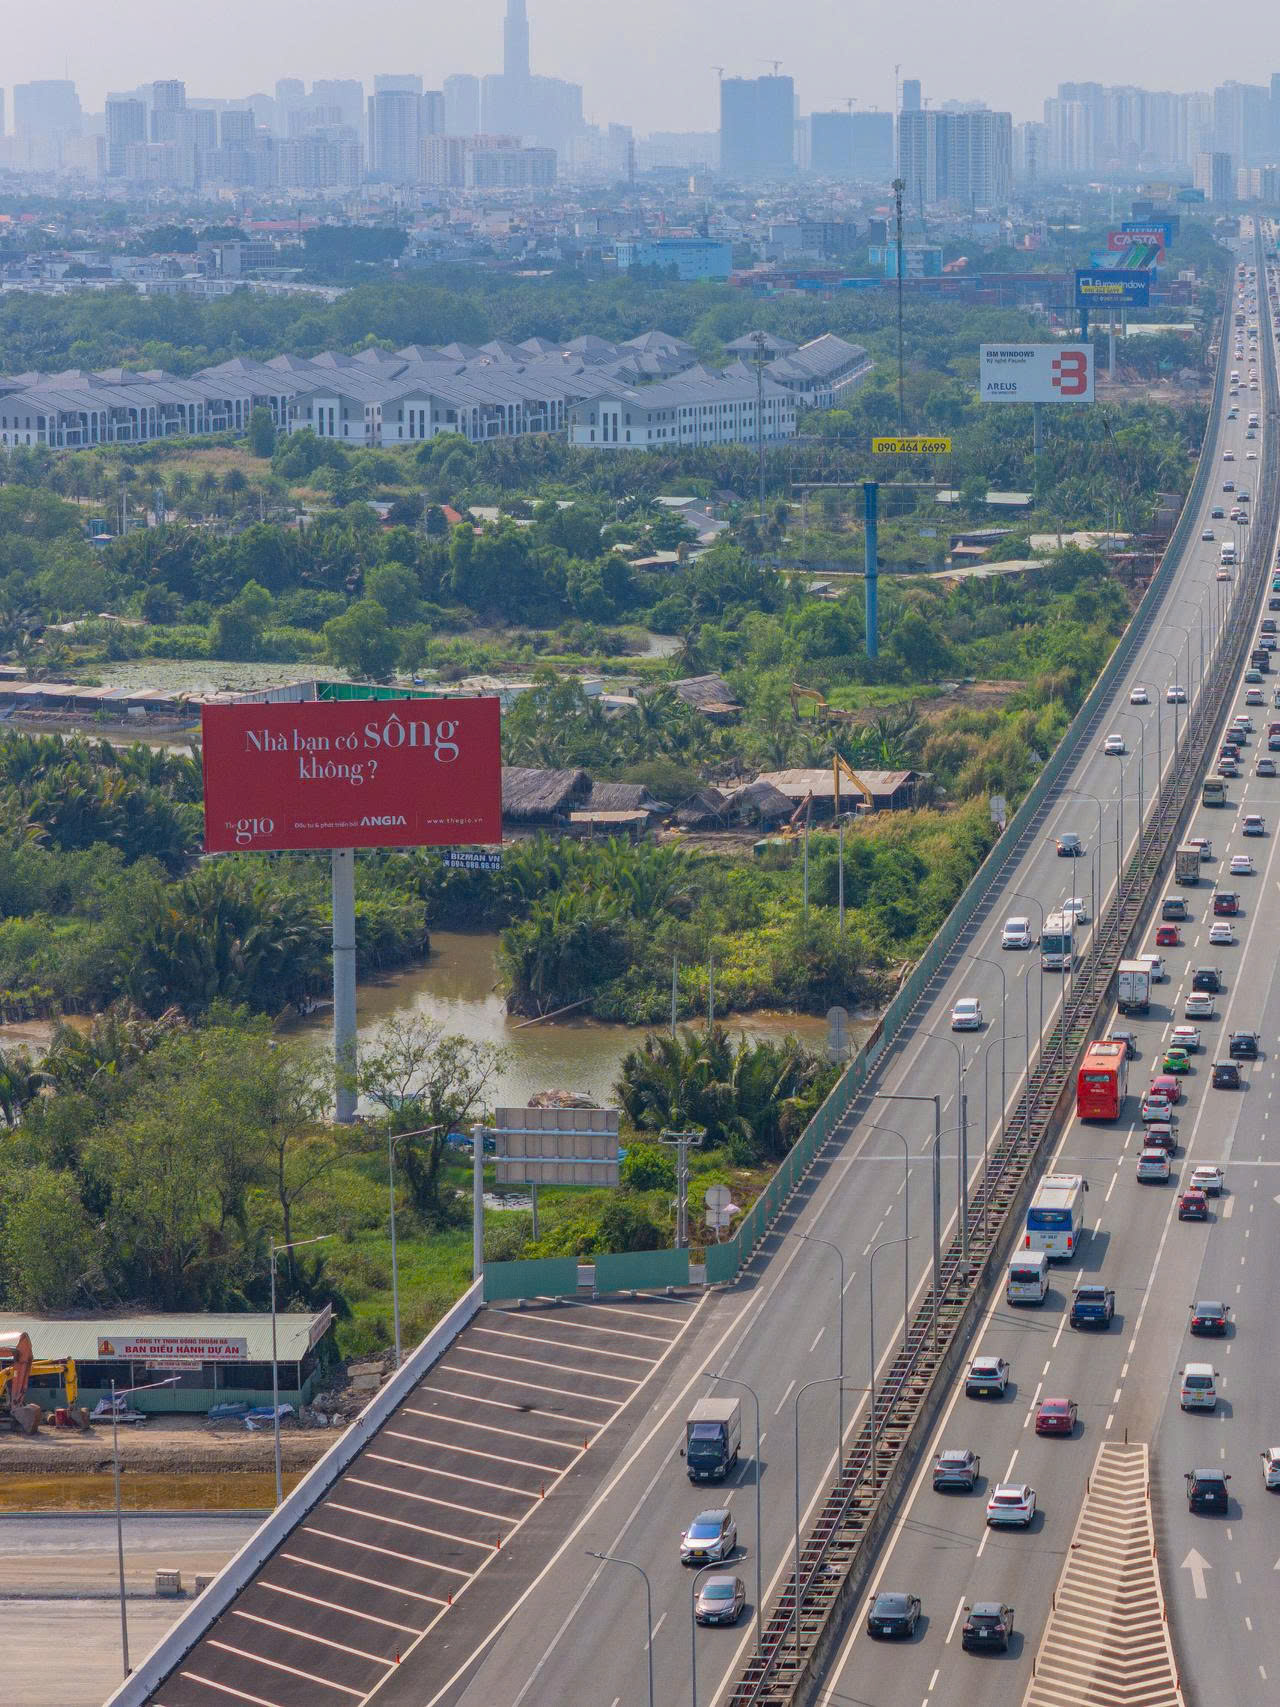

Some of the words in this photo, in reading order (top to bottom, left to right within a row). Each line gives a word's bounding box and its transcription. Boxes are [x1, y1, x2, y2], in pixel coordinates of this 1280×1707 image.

[1114, 234, 1158, 245] CASTA
[878, 443, 896, 452] 090
[900, 443, 918, 452] 464
[922, 443, 946, 452] 6699
[245, 730, 288, 751] Nhà
[294, 730, 329, 755] bạn
[335, 732, 358, 750] có
[364, 712, 460, 763] sông
[300, 757, 364, 785] không
[368, 760, 378, 779] ?
[360, 815, 407, 826] ANGIA
[150, 1344, 173, 1353] ĐIỀU
[176, 1345, 204, 1353] HÀNH
[225, 1345, 239, 1353] ÁN
